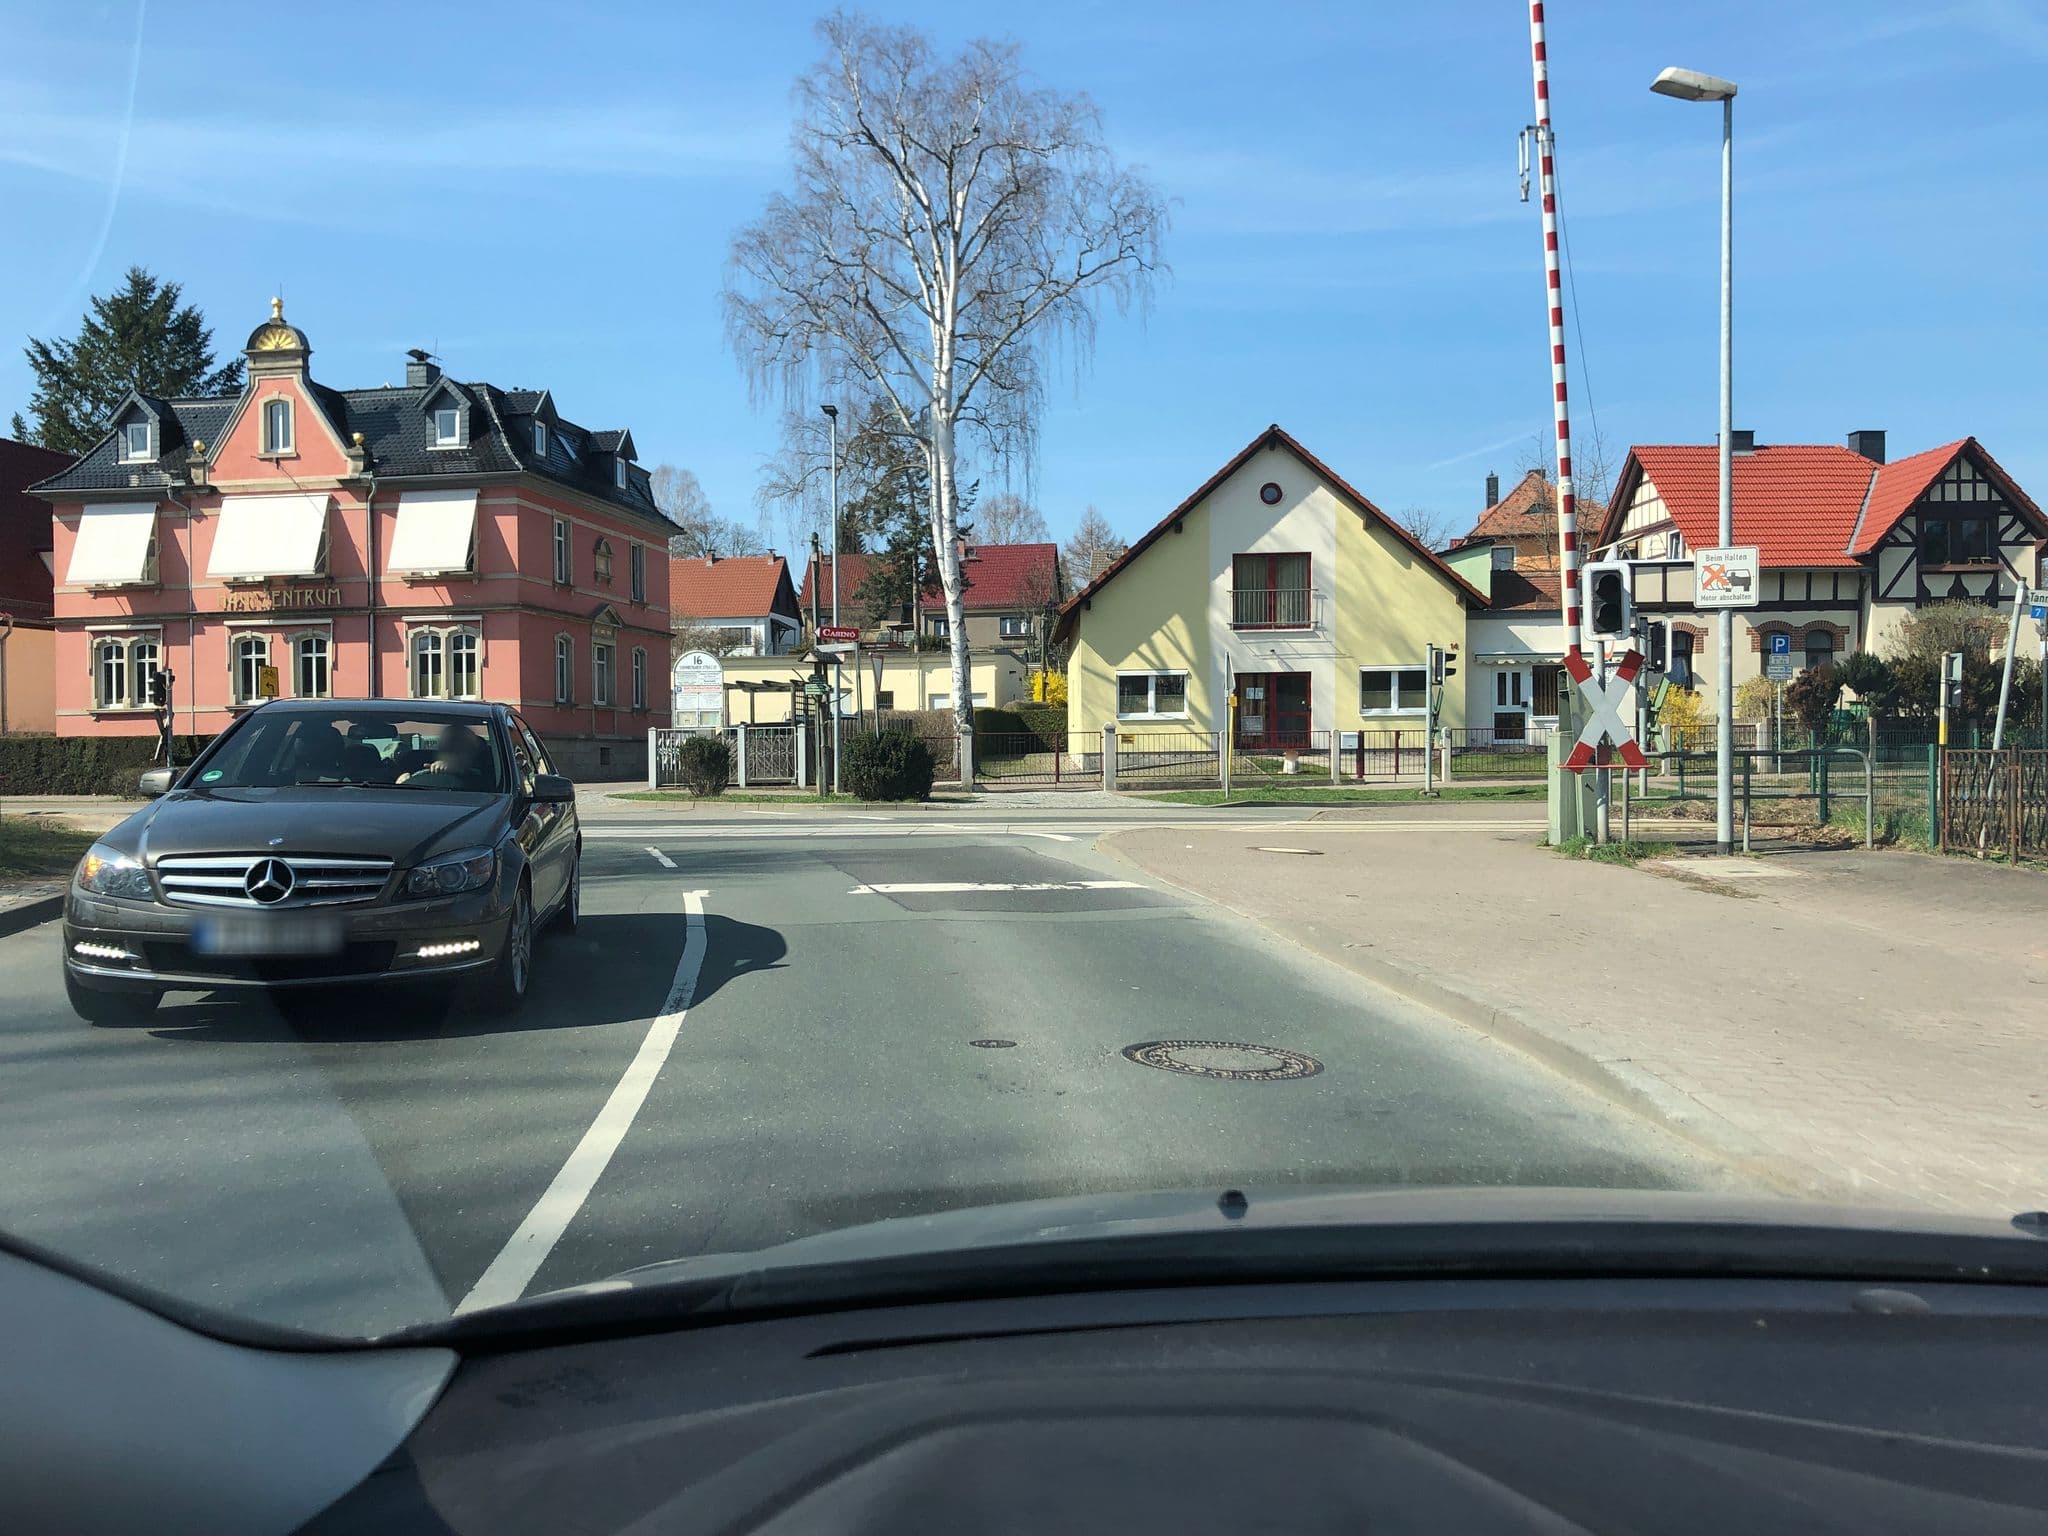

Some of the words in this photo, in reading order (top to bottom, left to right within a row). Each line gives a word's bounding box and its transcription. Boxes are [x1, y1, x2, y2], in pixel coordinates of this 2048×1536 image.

[1705, 554, 1722, 562] Beim
[1725, 553, 1748, 561] Halten
[1720, 593, 1752, 601] abschalten
[2034, 608, 2042, 617] 7
[1775, 637, 1786, 652] P
[693, 655, 703, 665] 16
